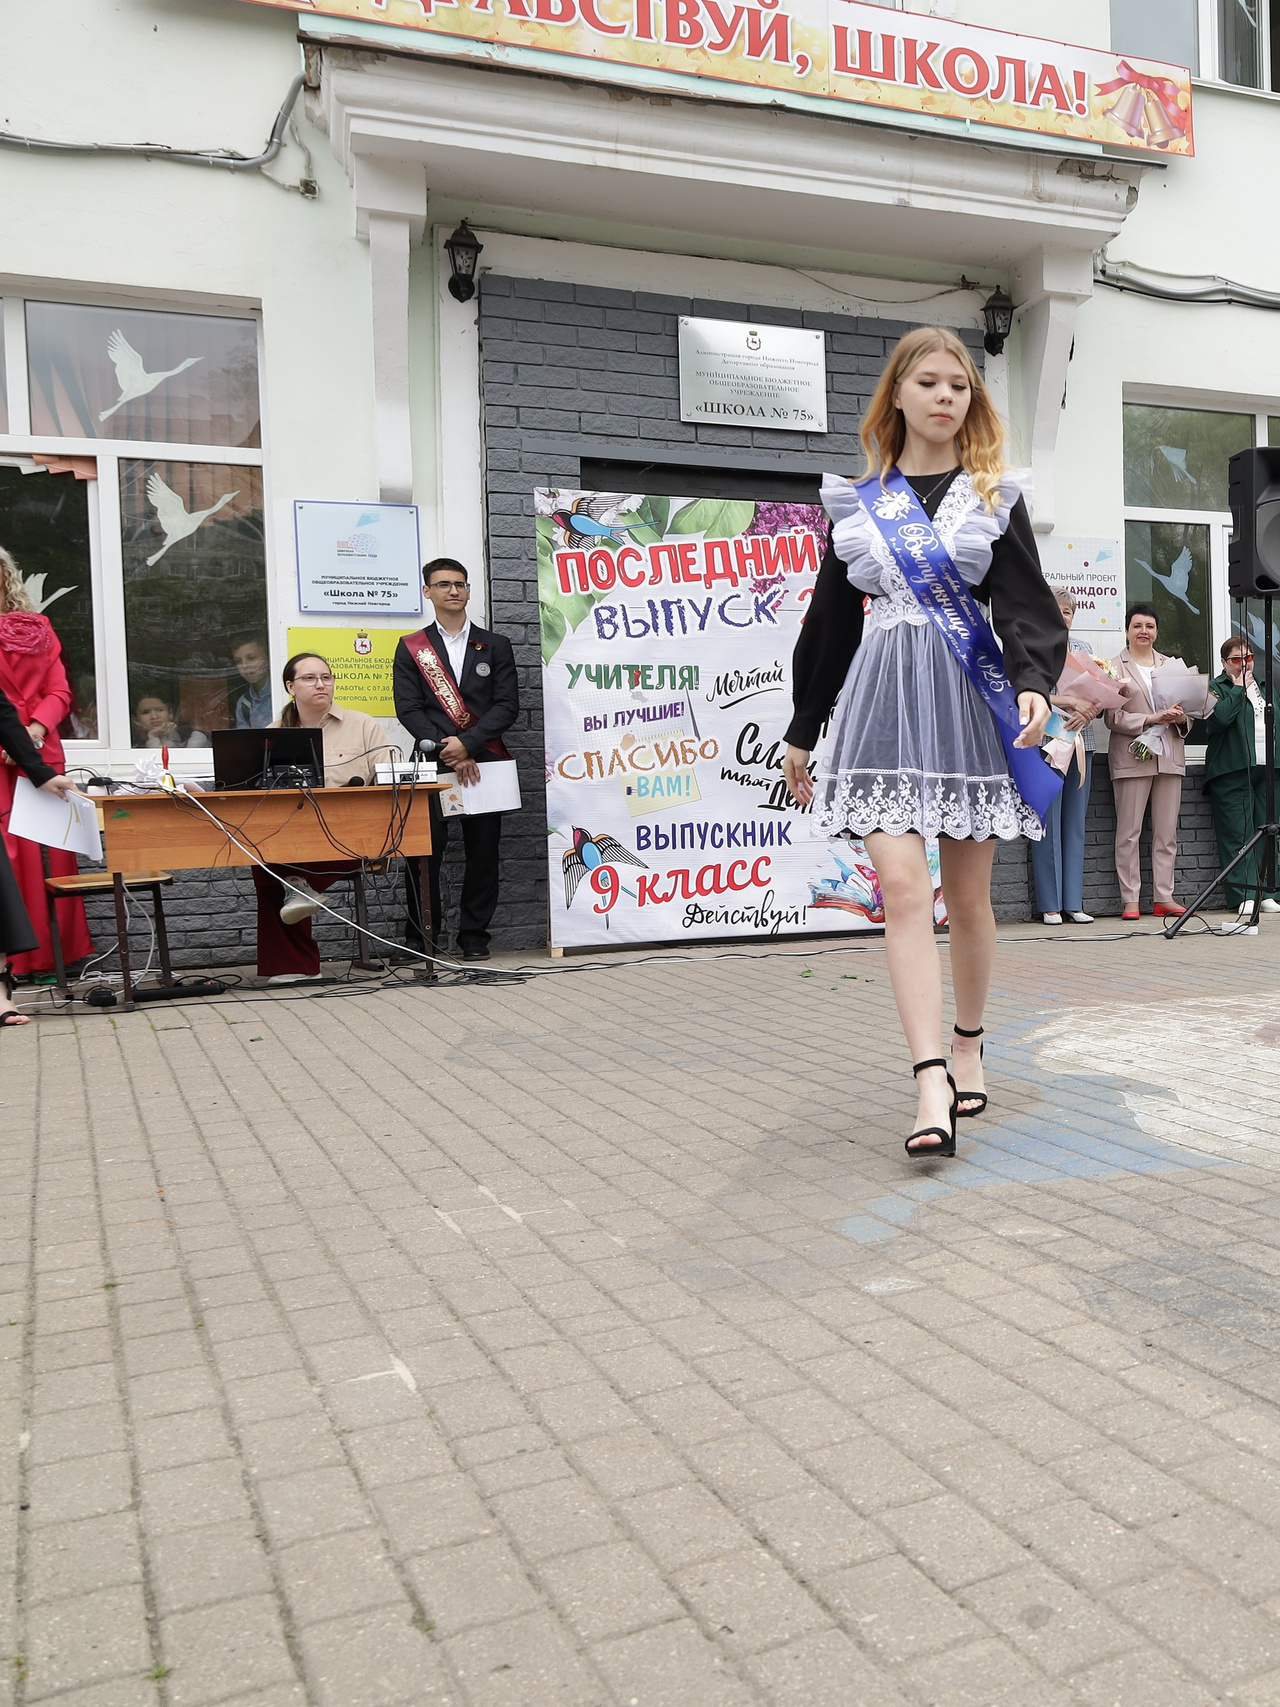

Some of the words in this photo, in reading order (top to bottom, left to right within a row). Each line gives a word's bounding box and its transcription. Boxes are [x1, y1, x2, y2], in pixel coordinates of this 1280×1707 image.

[831, 24, 1087, 114] ШКОЛА!
[695, 371, 763, 382] МУНИЦИПАЛЬНОЕ
[764, 377, 812, 387] БЮДЖЕТНОЕ
[709, 380, 800, 393] ОБЩЕОБРАЗОВАТЕЛЬНОЕ
[730, 389, 780, 399] УЧРЕЖДЕНИЕ
[695, 402, 766, 418] «ШКОЛА
[770, 407, 789, 419] №
[792, 410, 814, 421] 75»
[556, 529, 818, 593] ПОСЛЕДНИЙ
[897, 523, 970, 640] Выпускница
[1086, 573, 1117, 582] ПРОЕКТ
[323, 589, 365, 598] «Школа
[367, 590, 379, 598] №
[381, 590, 399, 598] 75»
[593, 587, 782, 641] ВЫПУСК
[565, 664, 700, 691] УЧИТЕЛЯ!
[705, 660, 788, 703] Мечтай
[583, 714, 608, 733] ВЫ
[613, 701, 686, 728] ЛУЧШИЕ!
[557, 738, 720, 781] СПАСИБО
[637, 774, 691, 798] ВАМ!
[720, 766, 773, 791] твой
[636, 820, 793, 851] ВЫПУСКНИК
[590, 865, 620, 915] 9
[636, 855, 772, 907] класс
[682, 889, 807, 935] Действуй!
